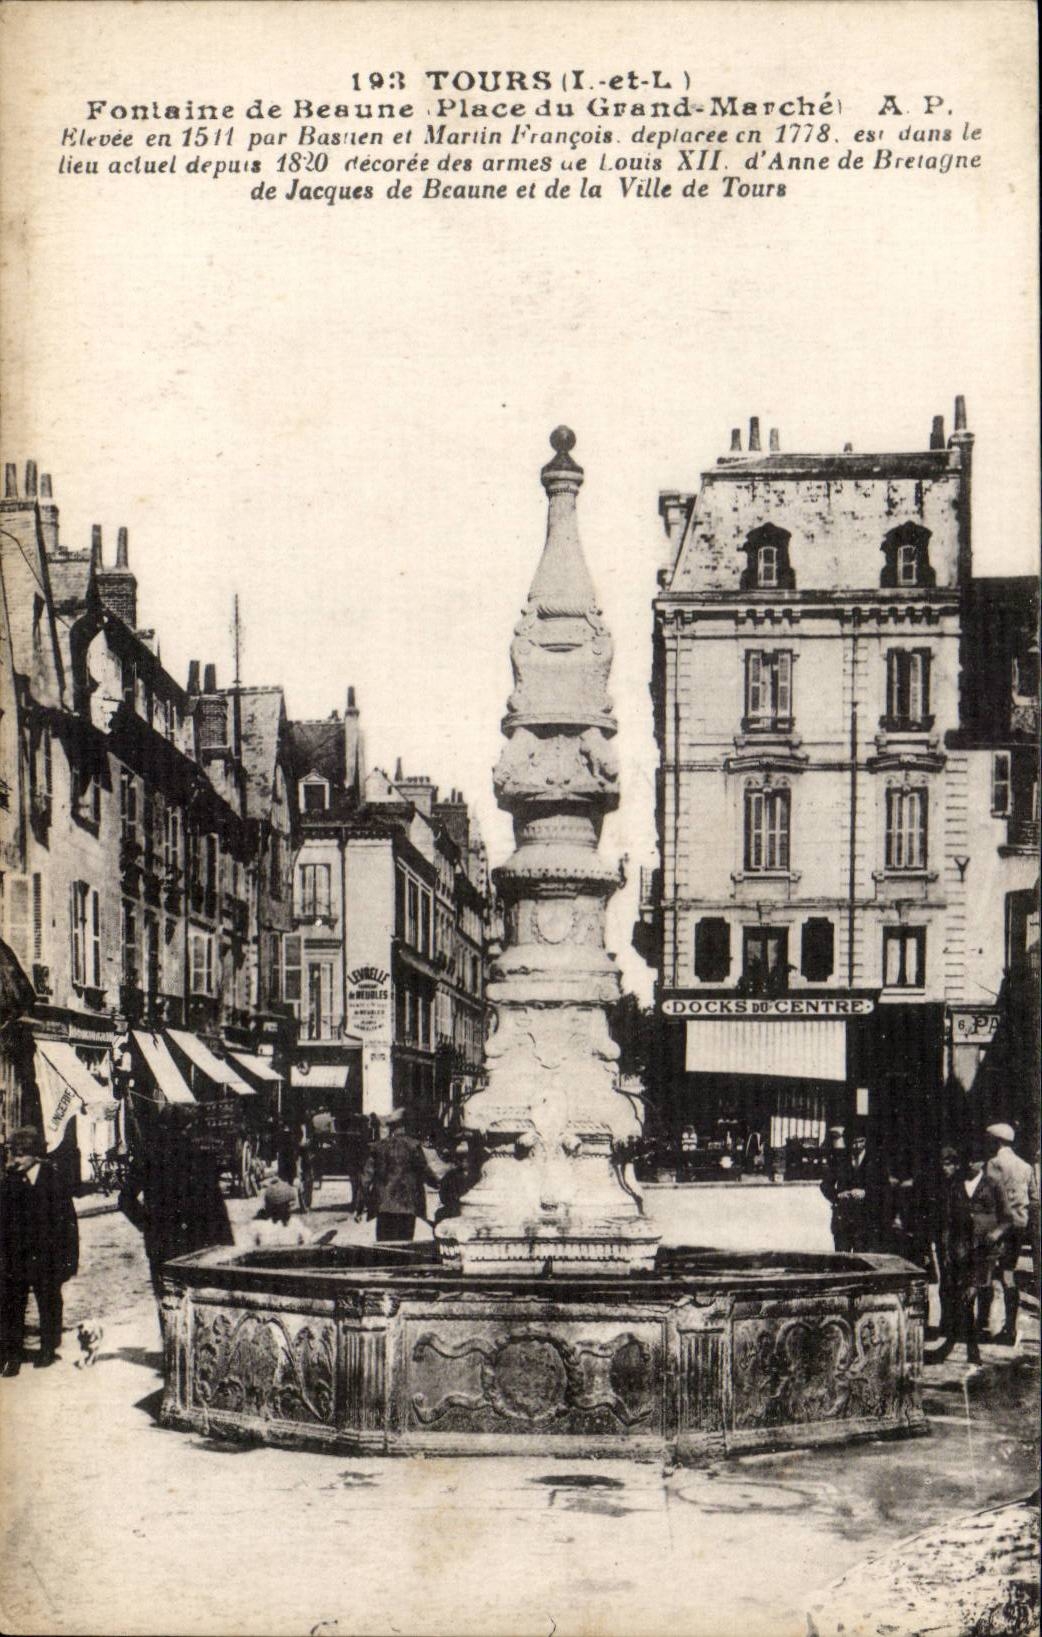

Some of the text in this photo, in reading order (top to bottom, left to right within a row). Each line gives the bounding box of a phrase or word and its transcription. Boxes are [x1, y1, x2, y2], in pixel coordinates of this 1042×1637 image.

[672, 1000, 864, 1014] DOCKS DU CENTRE
